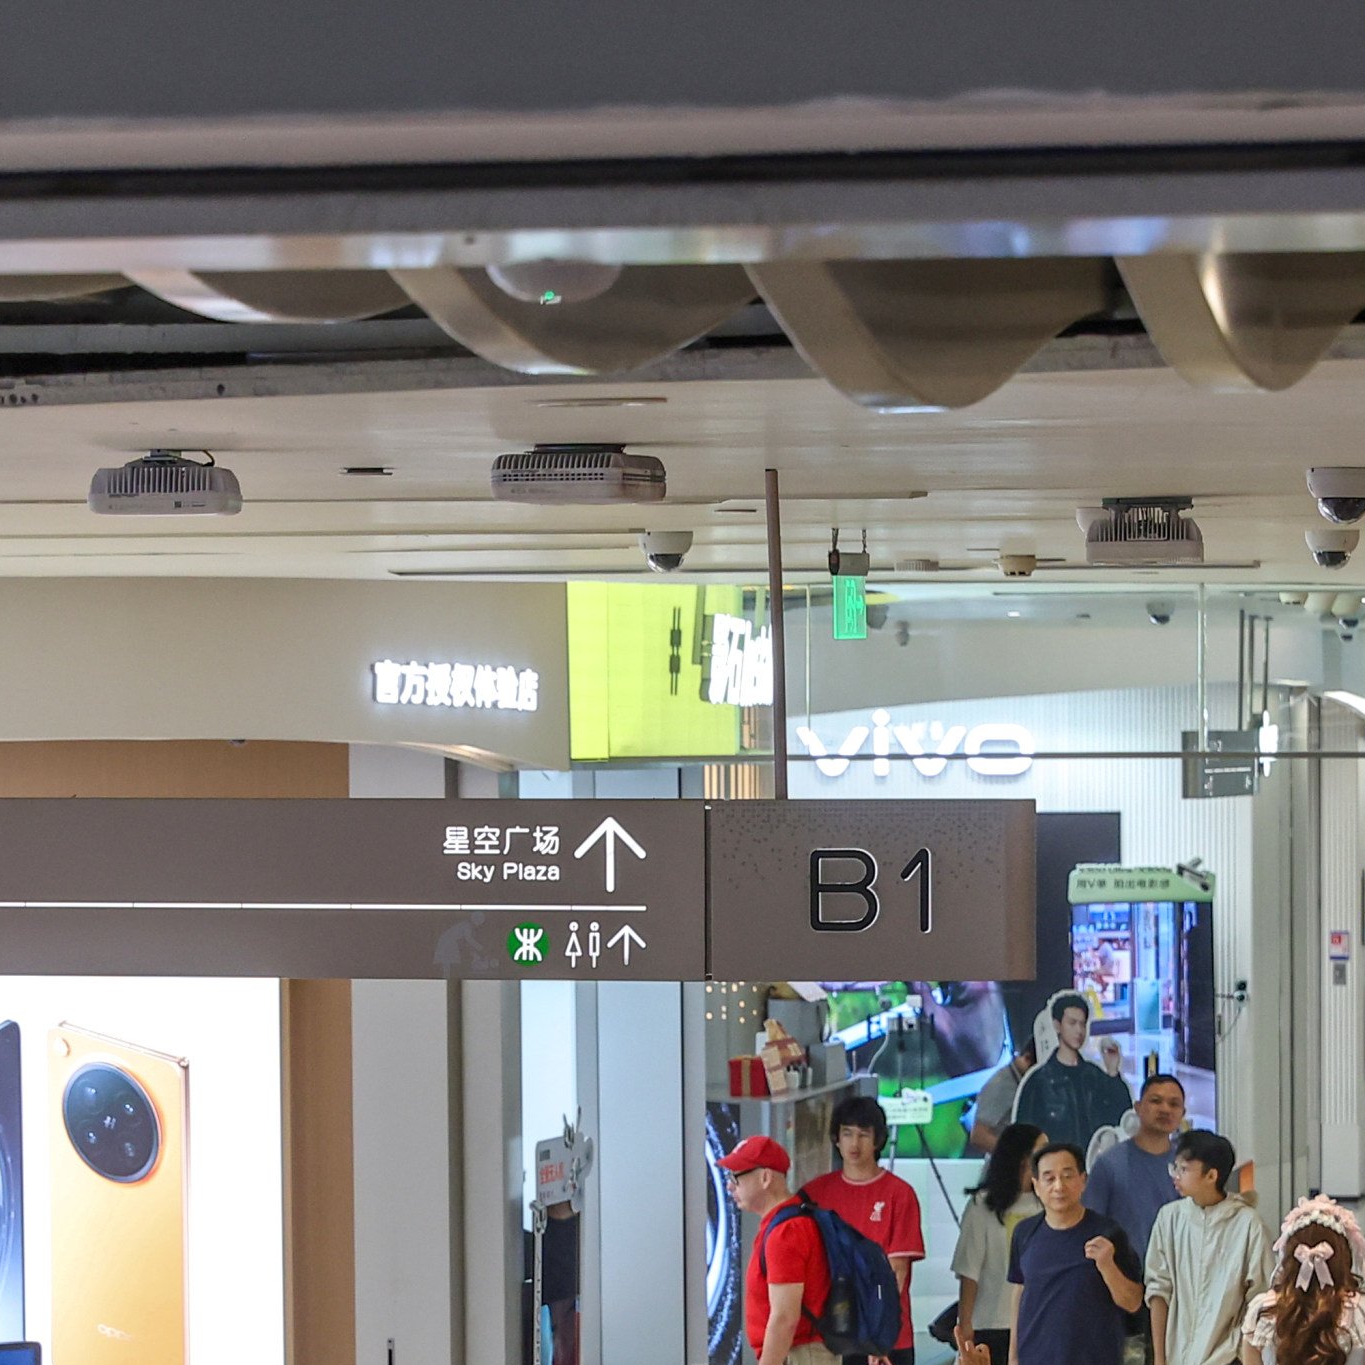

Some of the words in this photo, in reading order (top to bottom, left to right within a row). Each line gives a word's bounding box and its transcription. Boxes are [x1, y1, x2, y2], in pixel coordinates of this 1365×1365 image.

[796, 708, 1035, 777] vivo
[443, 825, 560, 856] 星空广场
[456, 862, 496, 883] Sky
[503, 862, 561, 882] Plaza
[809, 847, 932, 932] B1
